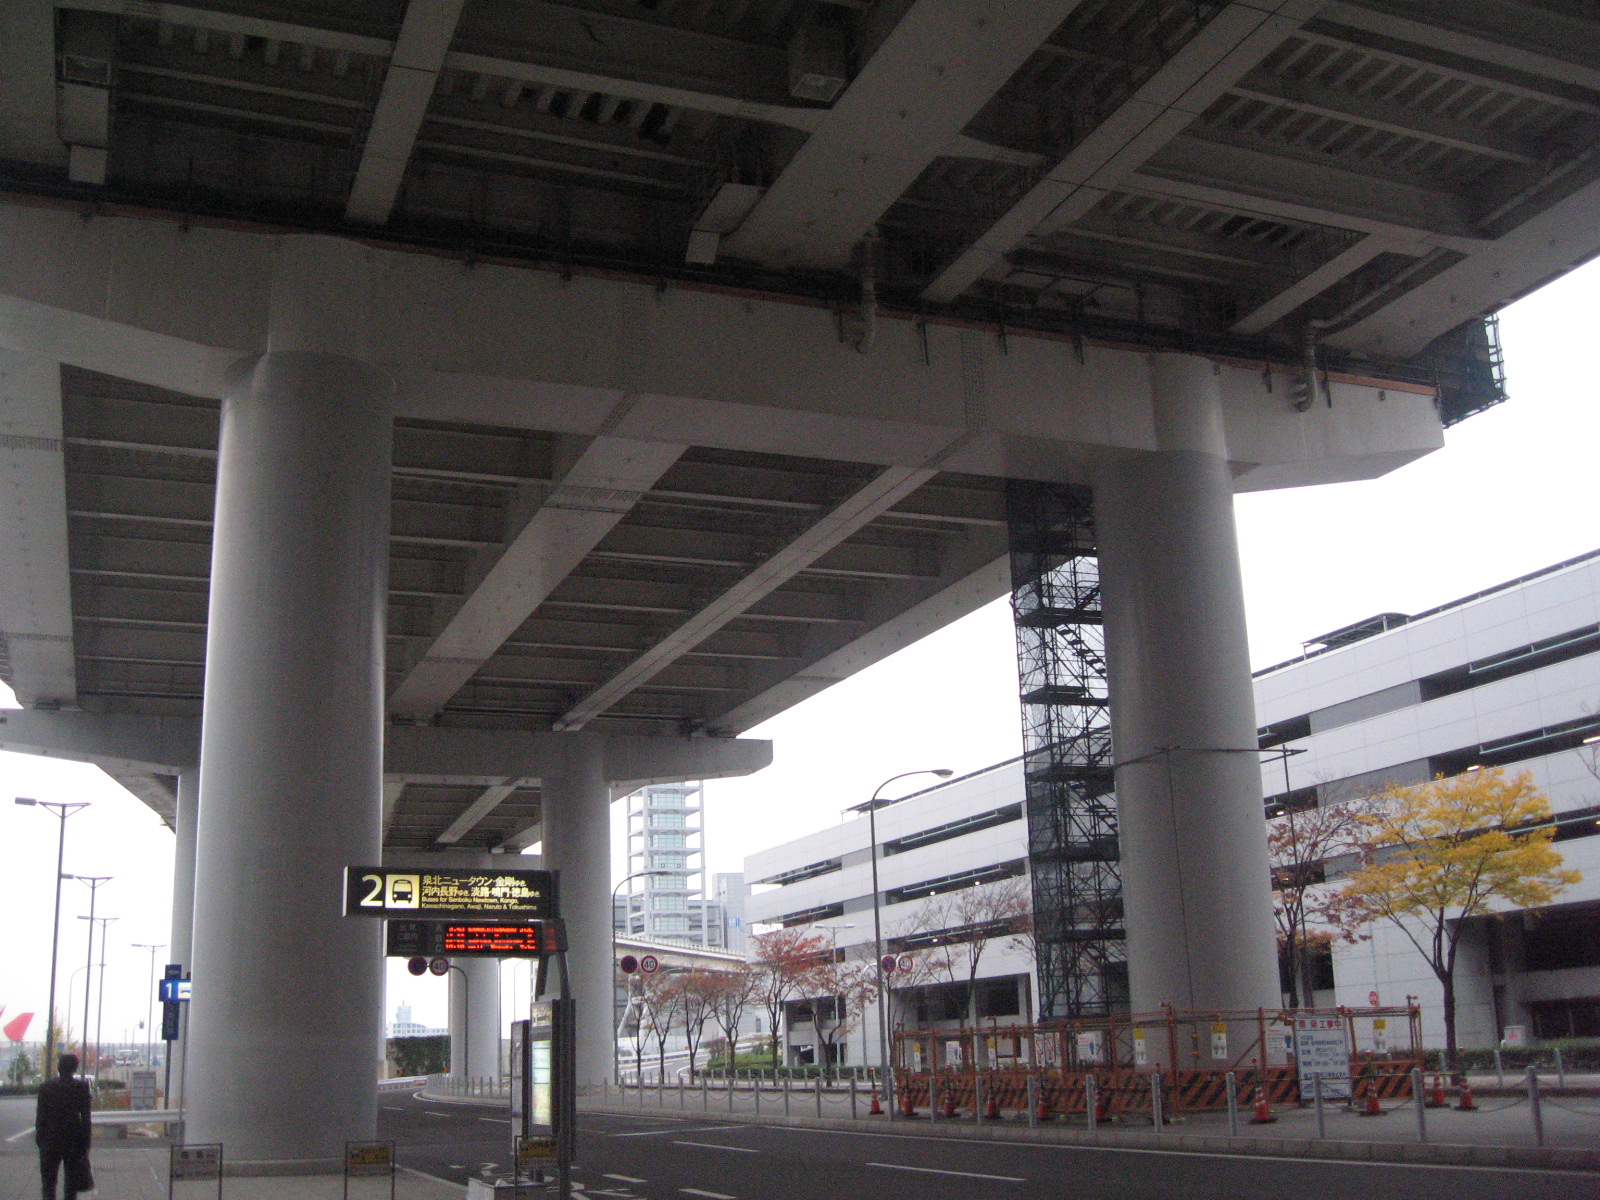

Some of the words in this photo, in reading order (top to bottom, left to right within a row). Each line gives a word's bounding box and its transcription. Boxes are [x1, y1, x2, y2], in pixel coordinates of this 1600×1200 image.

[360, 874, 383, 907] 2
[508, 903, 537, 911] Tokushima
[434, 962, 445, 971] 40
[644, 960, 655, 969] 40
[165, 982, 173, 999] 1
